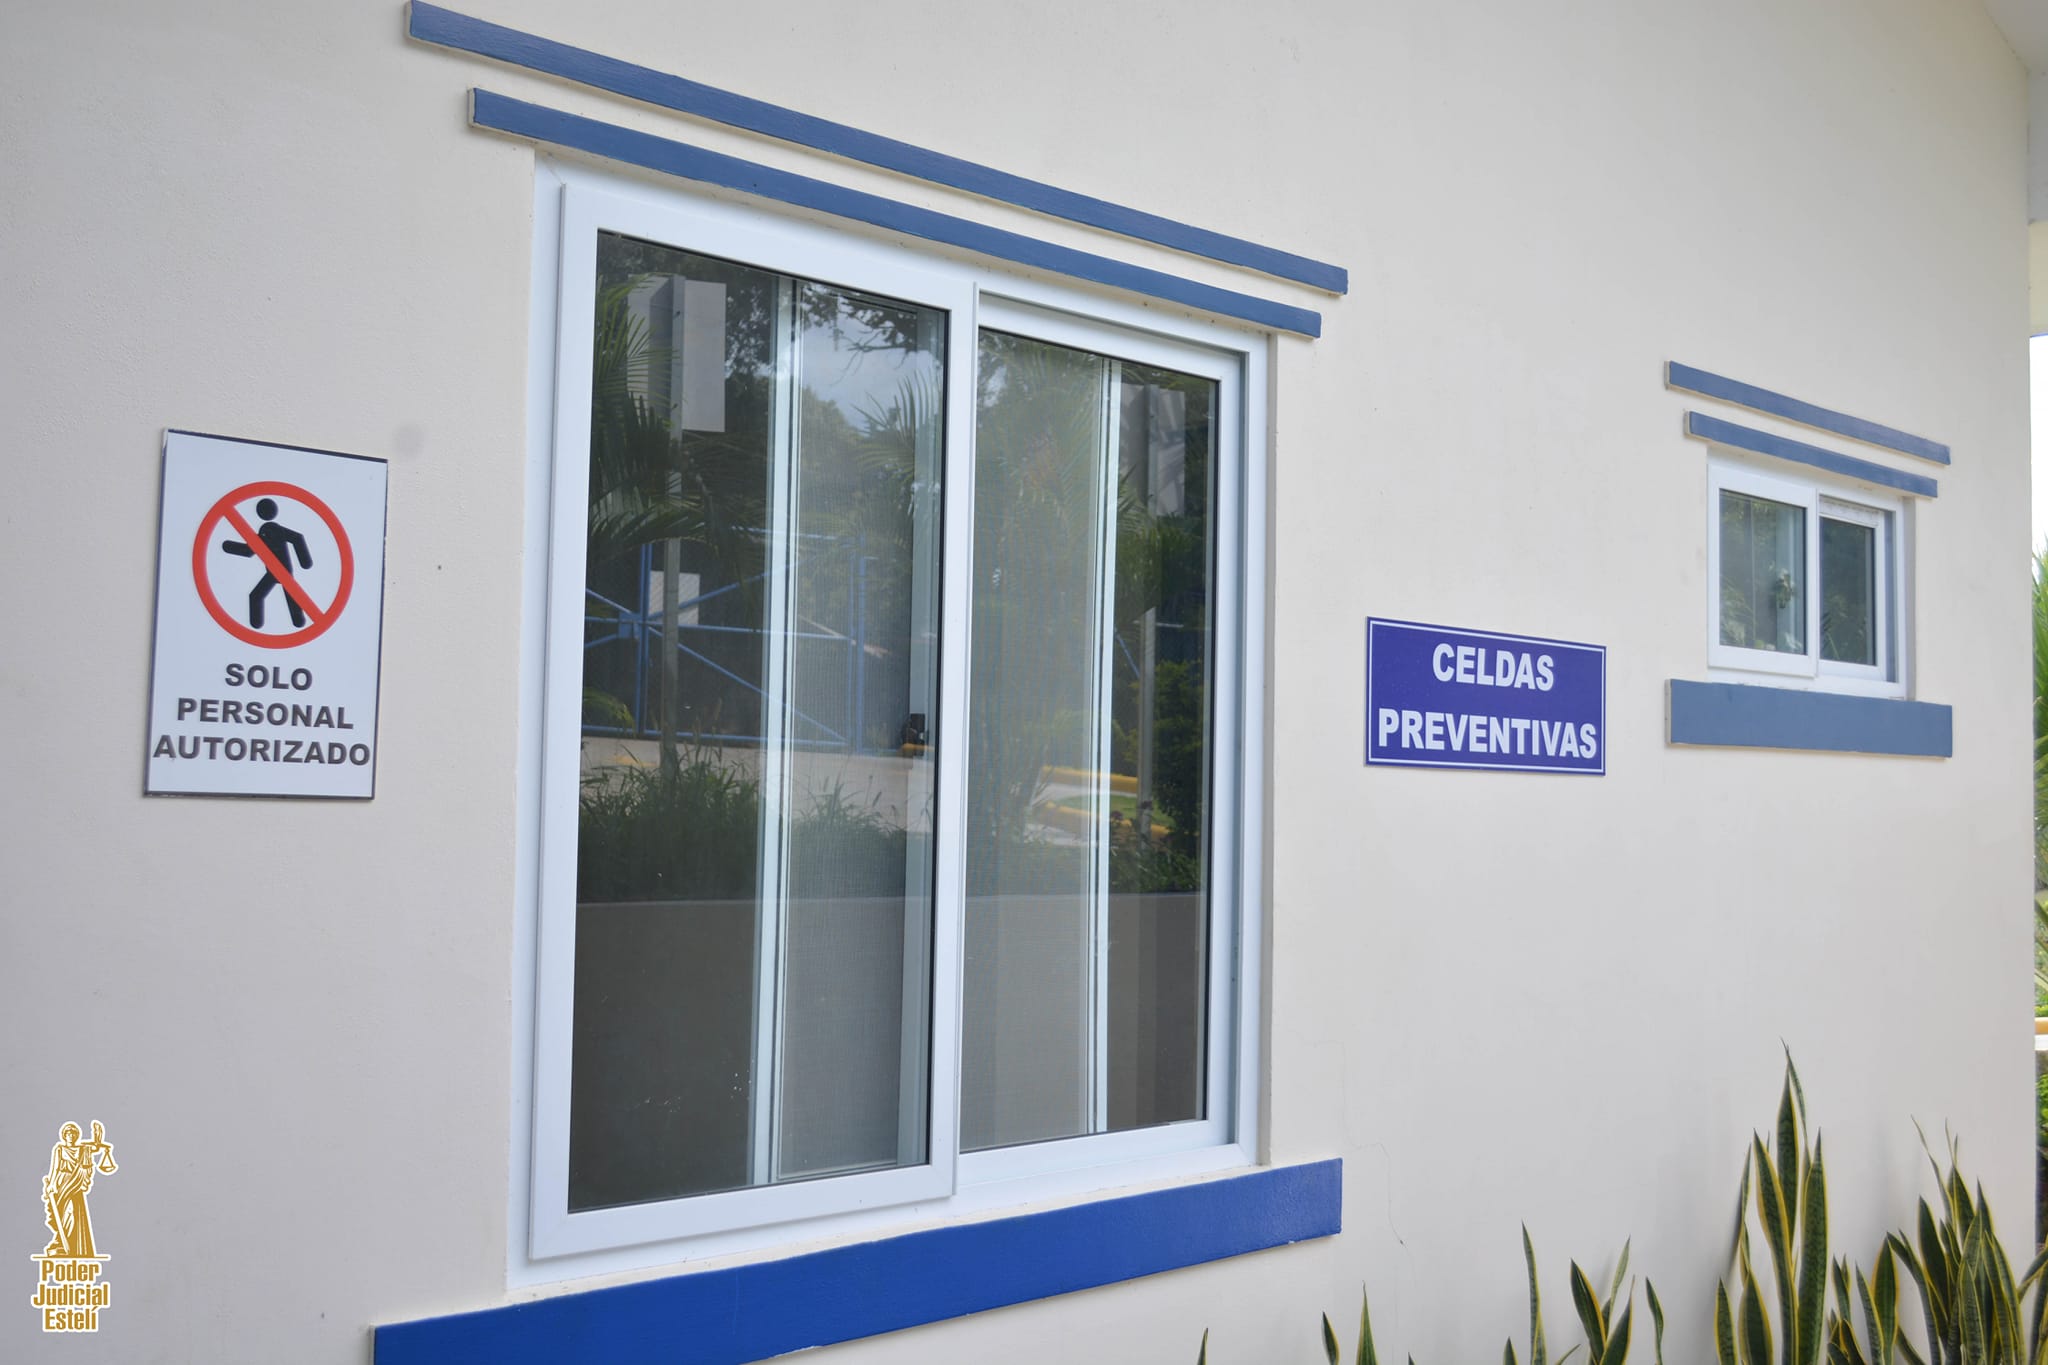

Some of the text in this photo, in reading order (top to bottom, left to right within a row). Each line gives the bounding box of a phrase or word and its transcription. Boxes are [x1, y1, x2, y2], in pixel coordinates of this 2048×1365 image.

[225, 662, 313, 691] SOLO
[1432, 642, 1554, 691] CELDAS
[177, 697, 354, 729] PERSONAL
[1378, 707, 1597, 759] PREVENTIVAS
[153, 734, 370, 766] AUTORIZADO
